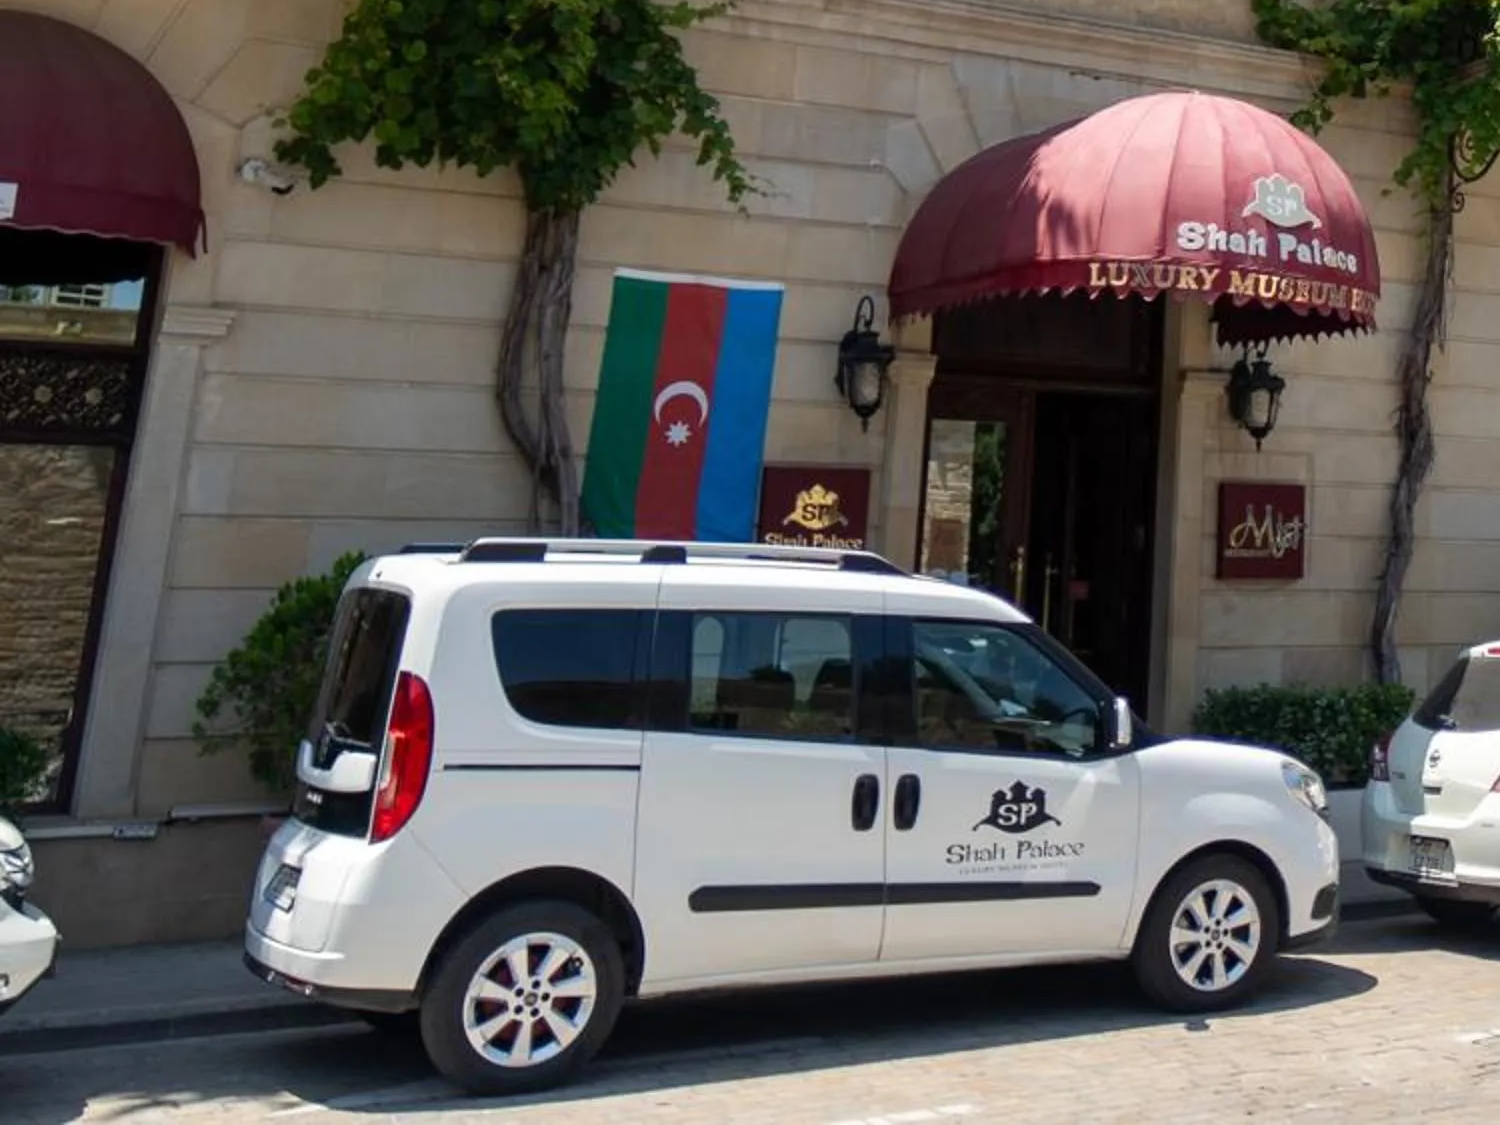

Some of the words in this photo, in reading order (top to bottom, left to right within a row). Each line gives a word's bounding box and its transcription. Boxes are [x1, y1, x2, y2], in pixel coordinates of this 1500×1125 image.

[1177, 221, 1267, 258] Shah
[1276, 232, 1357, 273] Palace
[1089, 262, 1220, 291] LUXURY
[1227, 269, 1348, 308] MUSEUM
[998, 802, 1037, 826] SP
[945, 842, 1006, 864] Shah
[1016, 839, 1085, 859] Palace
